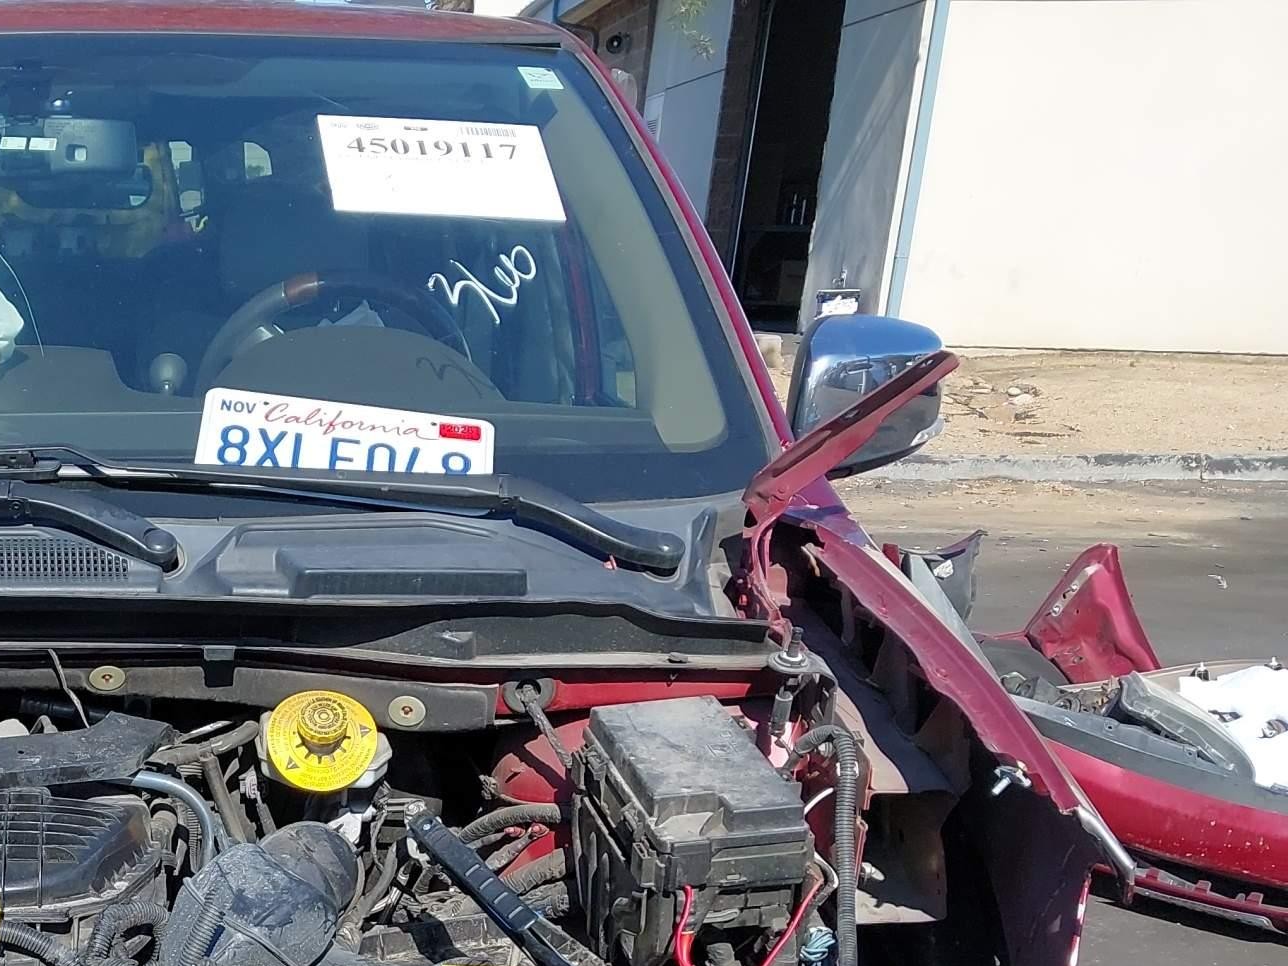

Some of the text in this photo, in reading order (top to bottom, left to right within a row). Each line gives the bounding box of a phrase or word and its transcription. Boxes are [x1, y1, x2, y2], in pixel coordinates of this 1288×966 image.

[346, 136, 518, 160] 45019117
[220, 399, 257, 414] NOV
[263, 402, 440, 441] California
